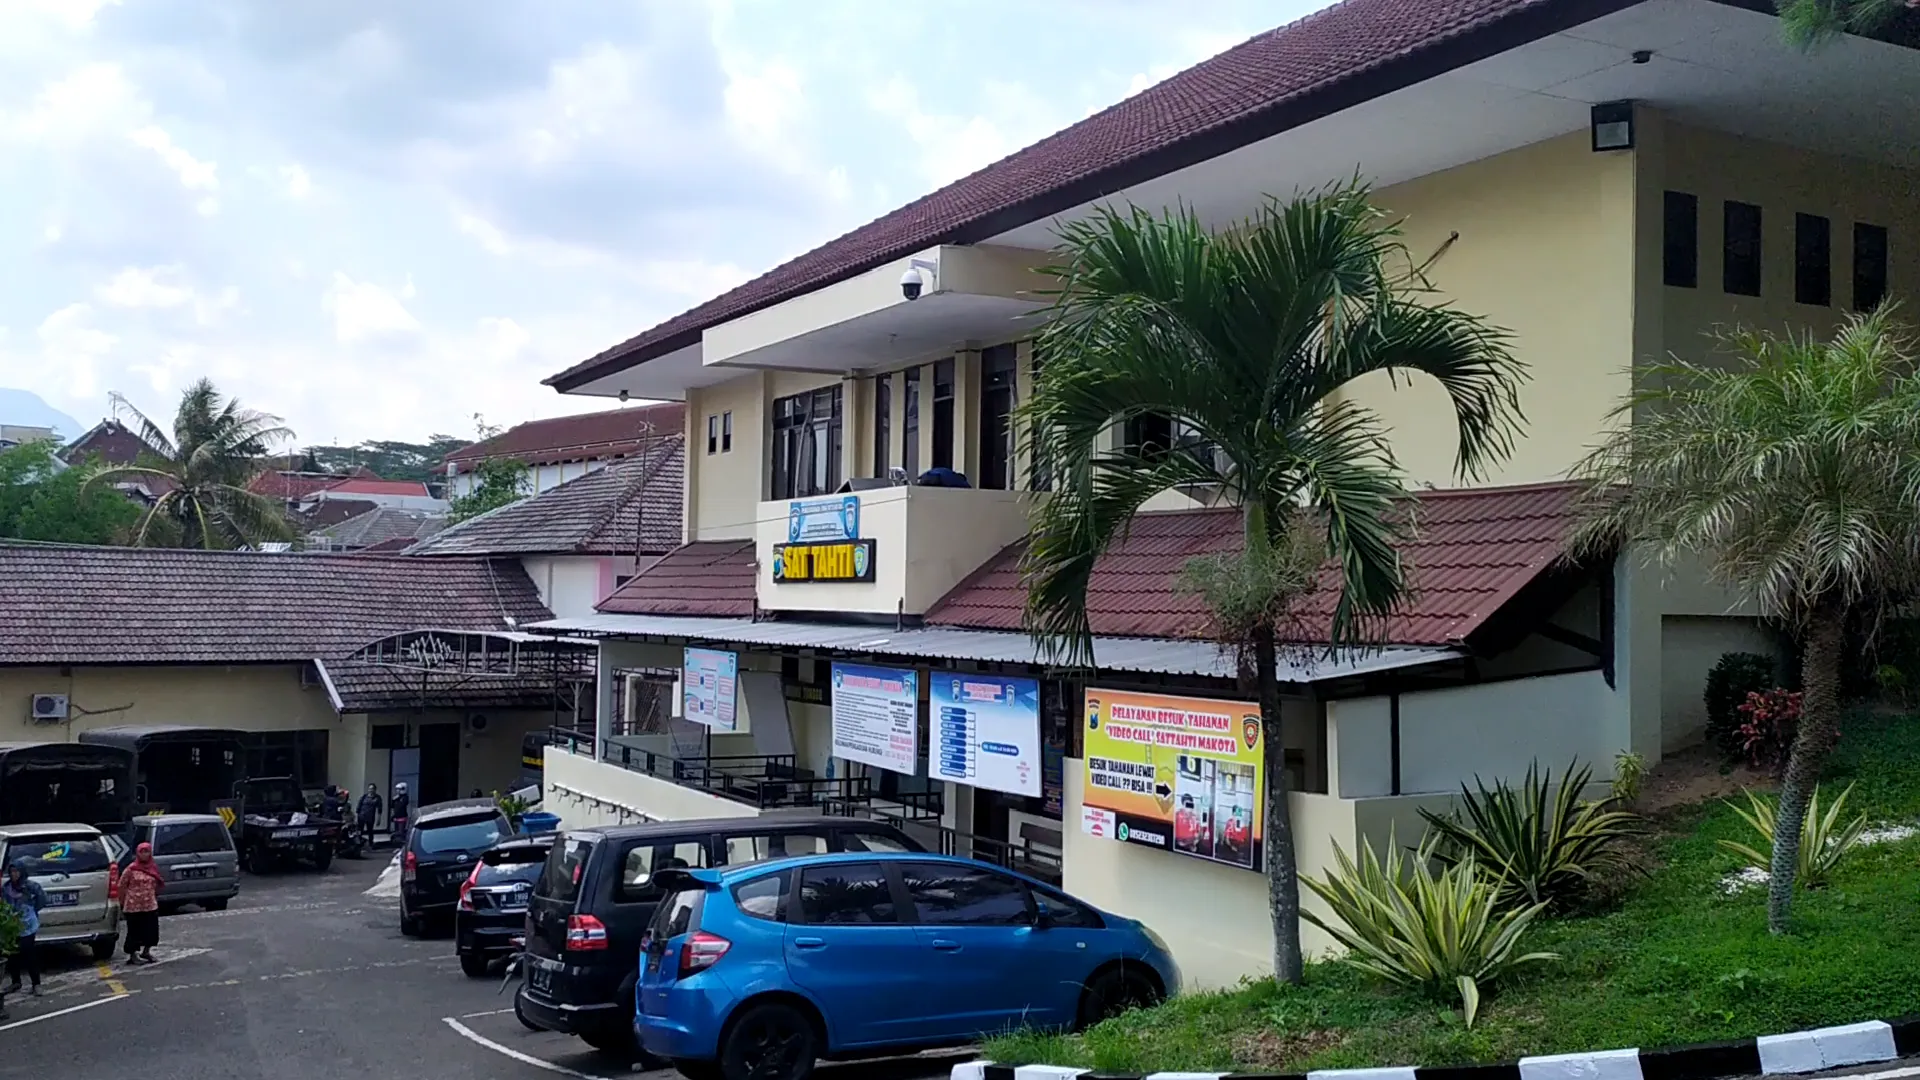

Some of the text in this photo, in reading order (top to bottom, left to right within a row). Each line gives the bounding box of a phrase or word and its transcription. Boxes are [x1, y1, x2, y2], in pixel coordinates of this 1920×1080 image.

[783, 544, 855, 579] SAT TAHTI
[1112, 706, 1156, 721] PELAYANAN
[1158, 710, 1184, 725] BESUK
[1188, 714, 1229, 730] TAHANAN
[1198, 736, 1236, 753] MAKOTA
[1089, 757, 1154, 778] BESUK TAHANAN LEWAT
[1091, 773, 1107, 785] VIDEO
[1108, 775, 1121, 788] CALL
[1131, 779, 1145, 793] BISA
